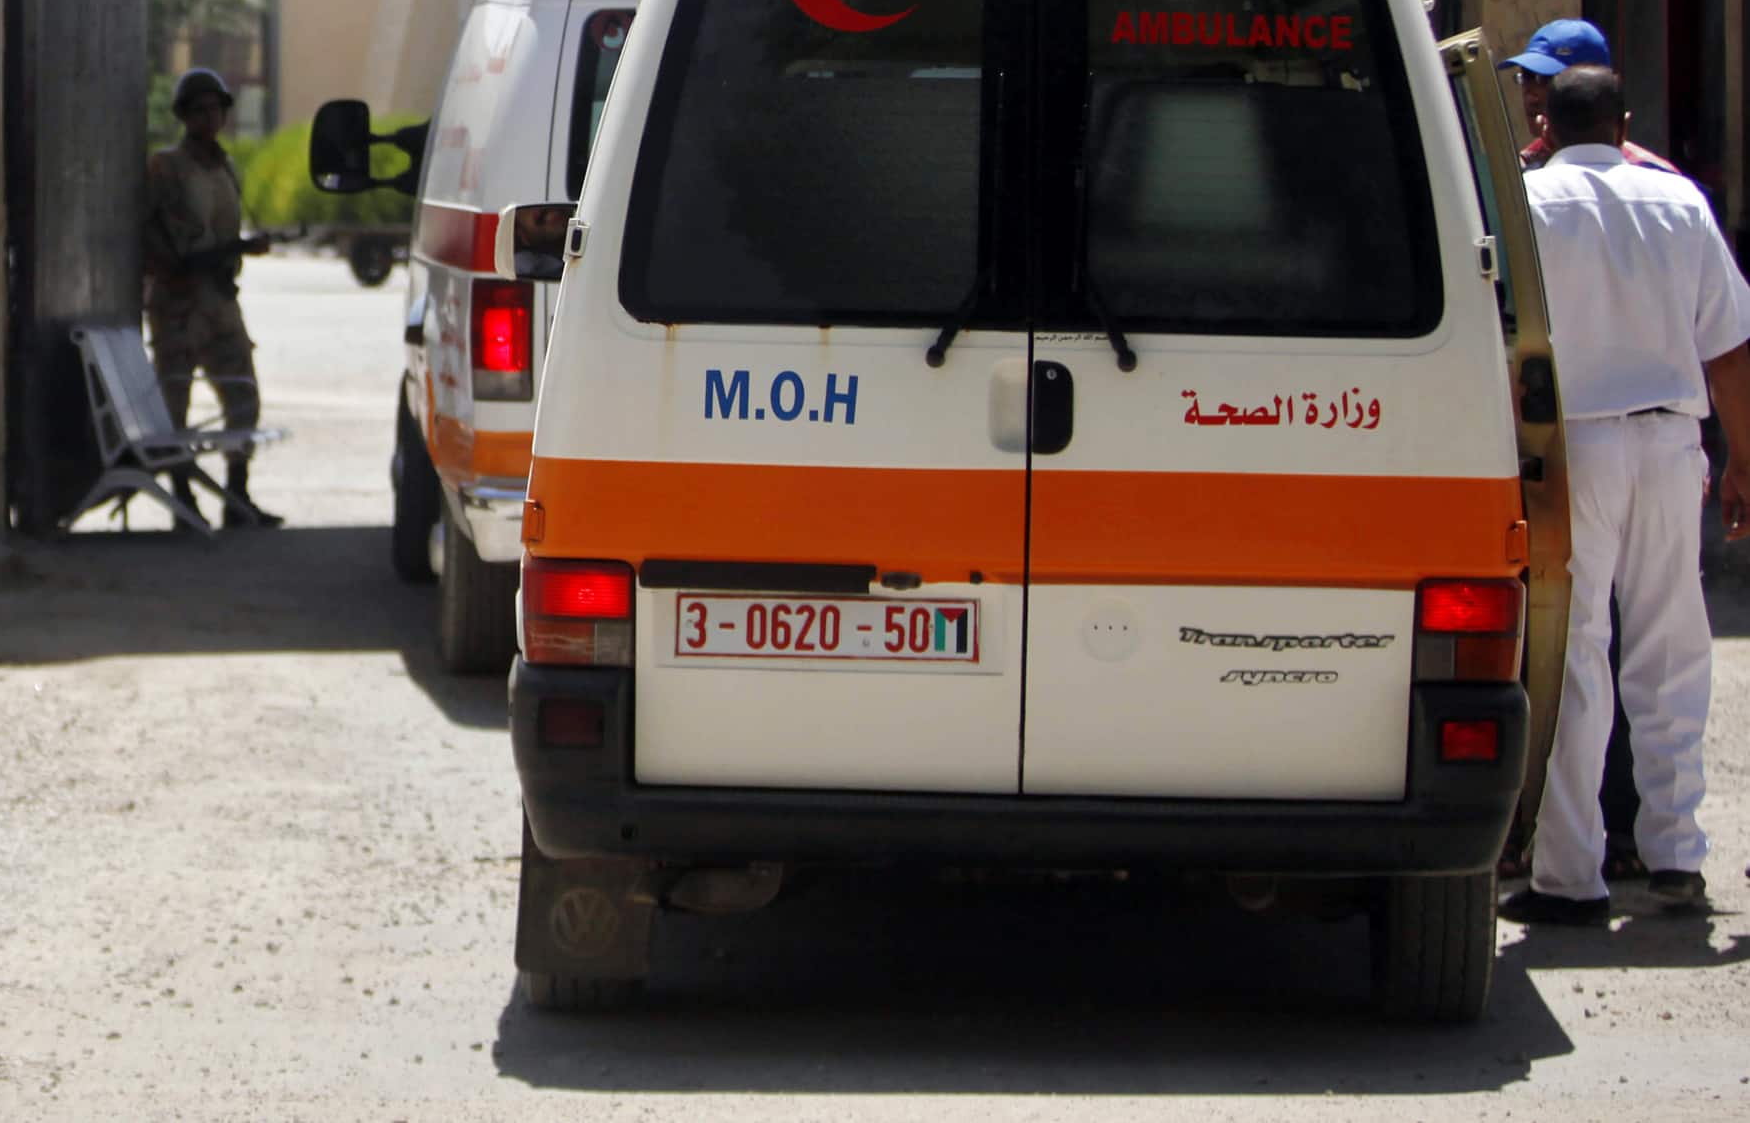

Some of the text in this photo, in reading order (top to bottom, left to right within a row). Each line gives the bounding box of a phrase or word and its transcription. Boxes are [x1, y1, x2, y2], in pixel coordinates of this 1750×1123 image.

[1111, 11, 1354, 49] AMBULANCE
[704, 370, 858, 425] M.O.H
[1181, 387, 1381, 429] وزارة الصحة
[1180, 627, 1395, 652] Transporter
